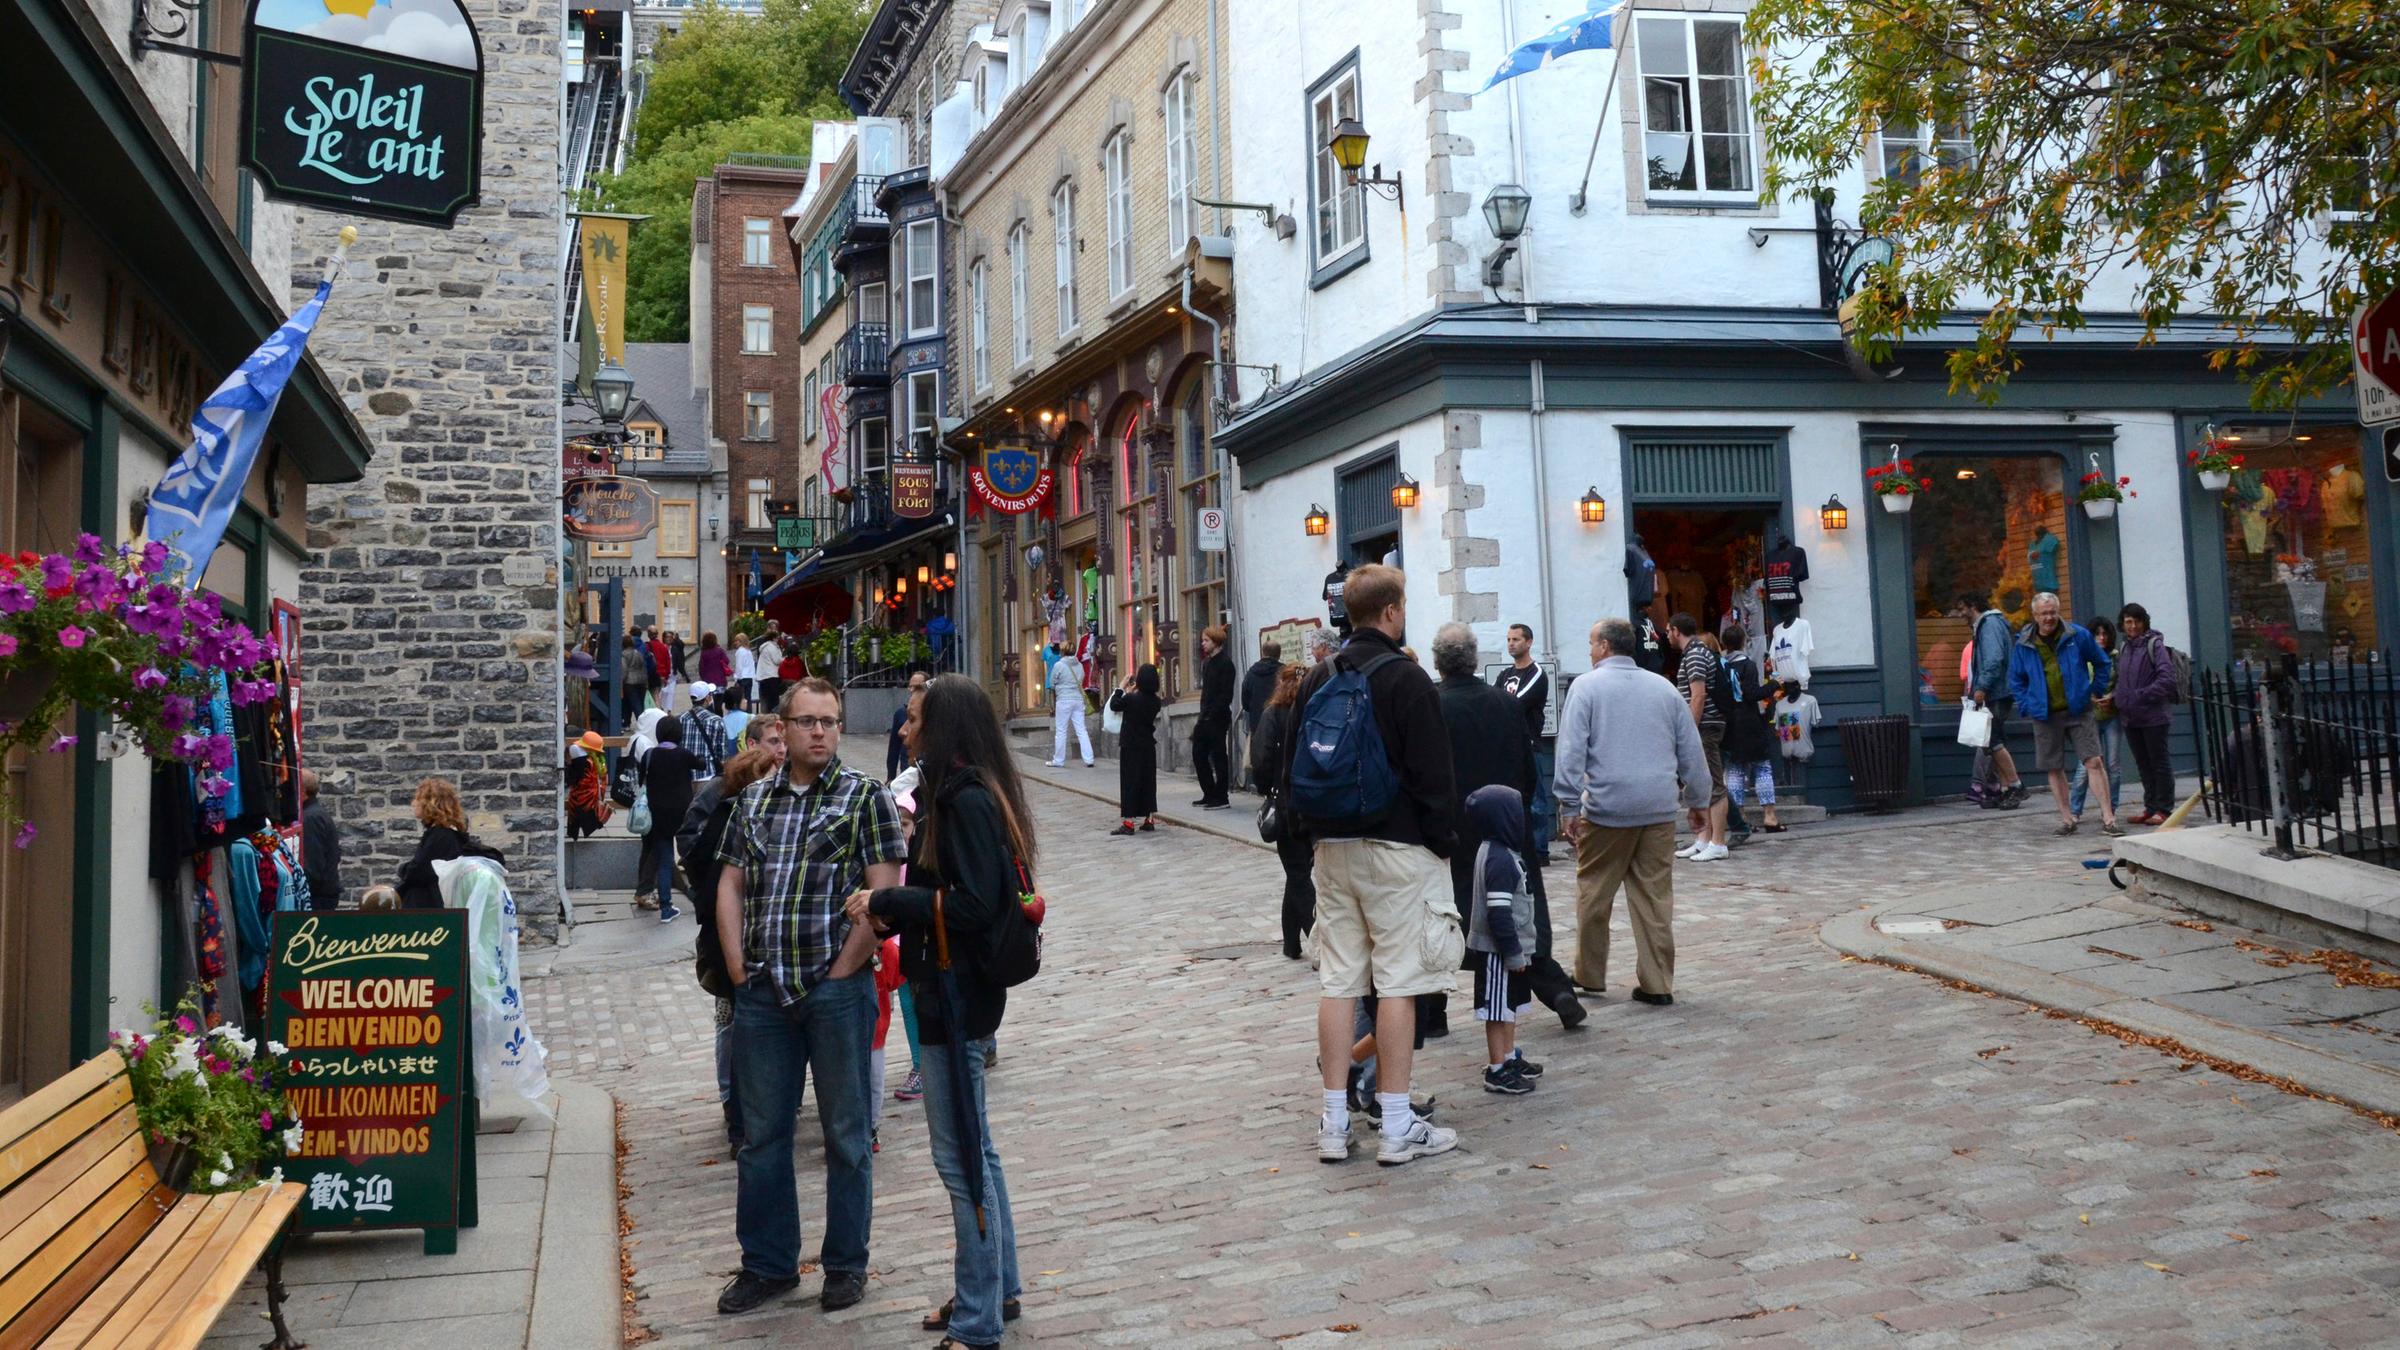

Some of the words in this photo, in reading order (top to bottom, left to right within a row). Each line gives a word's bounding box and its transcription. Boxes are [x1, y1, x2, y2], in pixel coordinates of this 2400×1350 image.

[284, 74, 423, 140] Soleil
[2364, 386, 2385, 406] 10h
[898, 477, 929, 488] SOUS
[908, 488, 920, 496] LE
[972, 471, 1026, 511] SOUVENIRS
[1026, 492, 1040, 506] DU
[1036, 474, 1051, 496] LYS
[897, 497, 931, 508] FORT
[282, 916, 450, 967] Bienvenue
[301, 979, 434, 1010] WELCOME
[287, 1015, 442, 1048] BIENVENIDO
[285, 1085, 438, 1117] WILLKOMMEN
